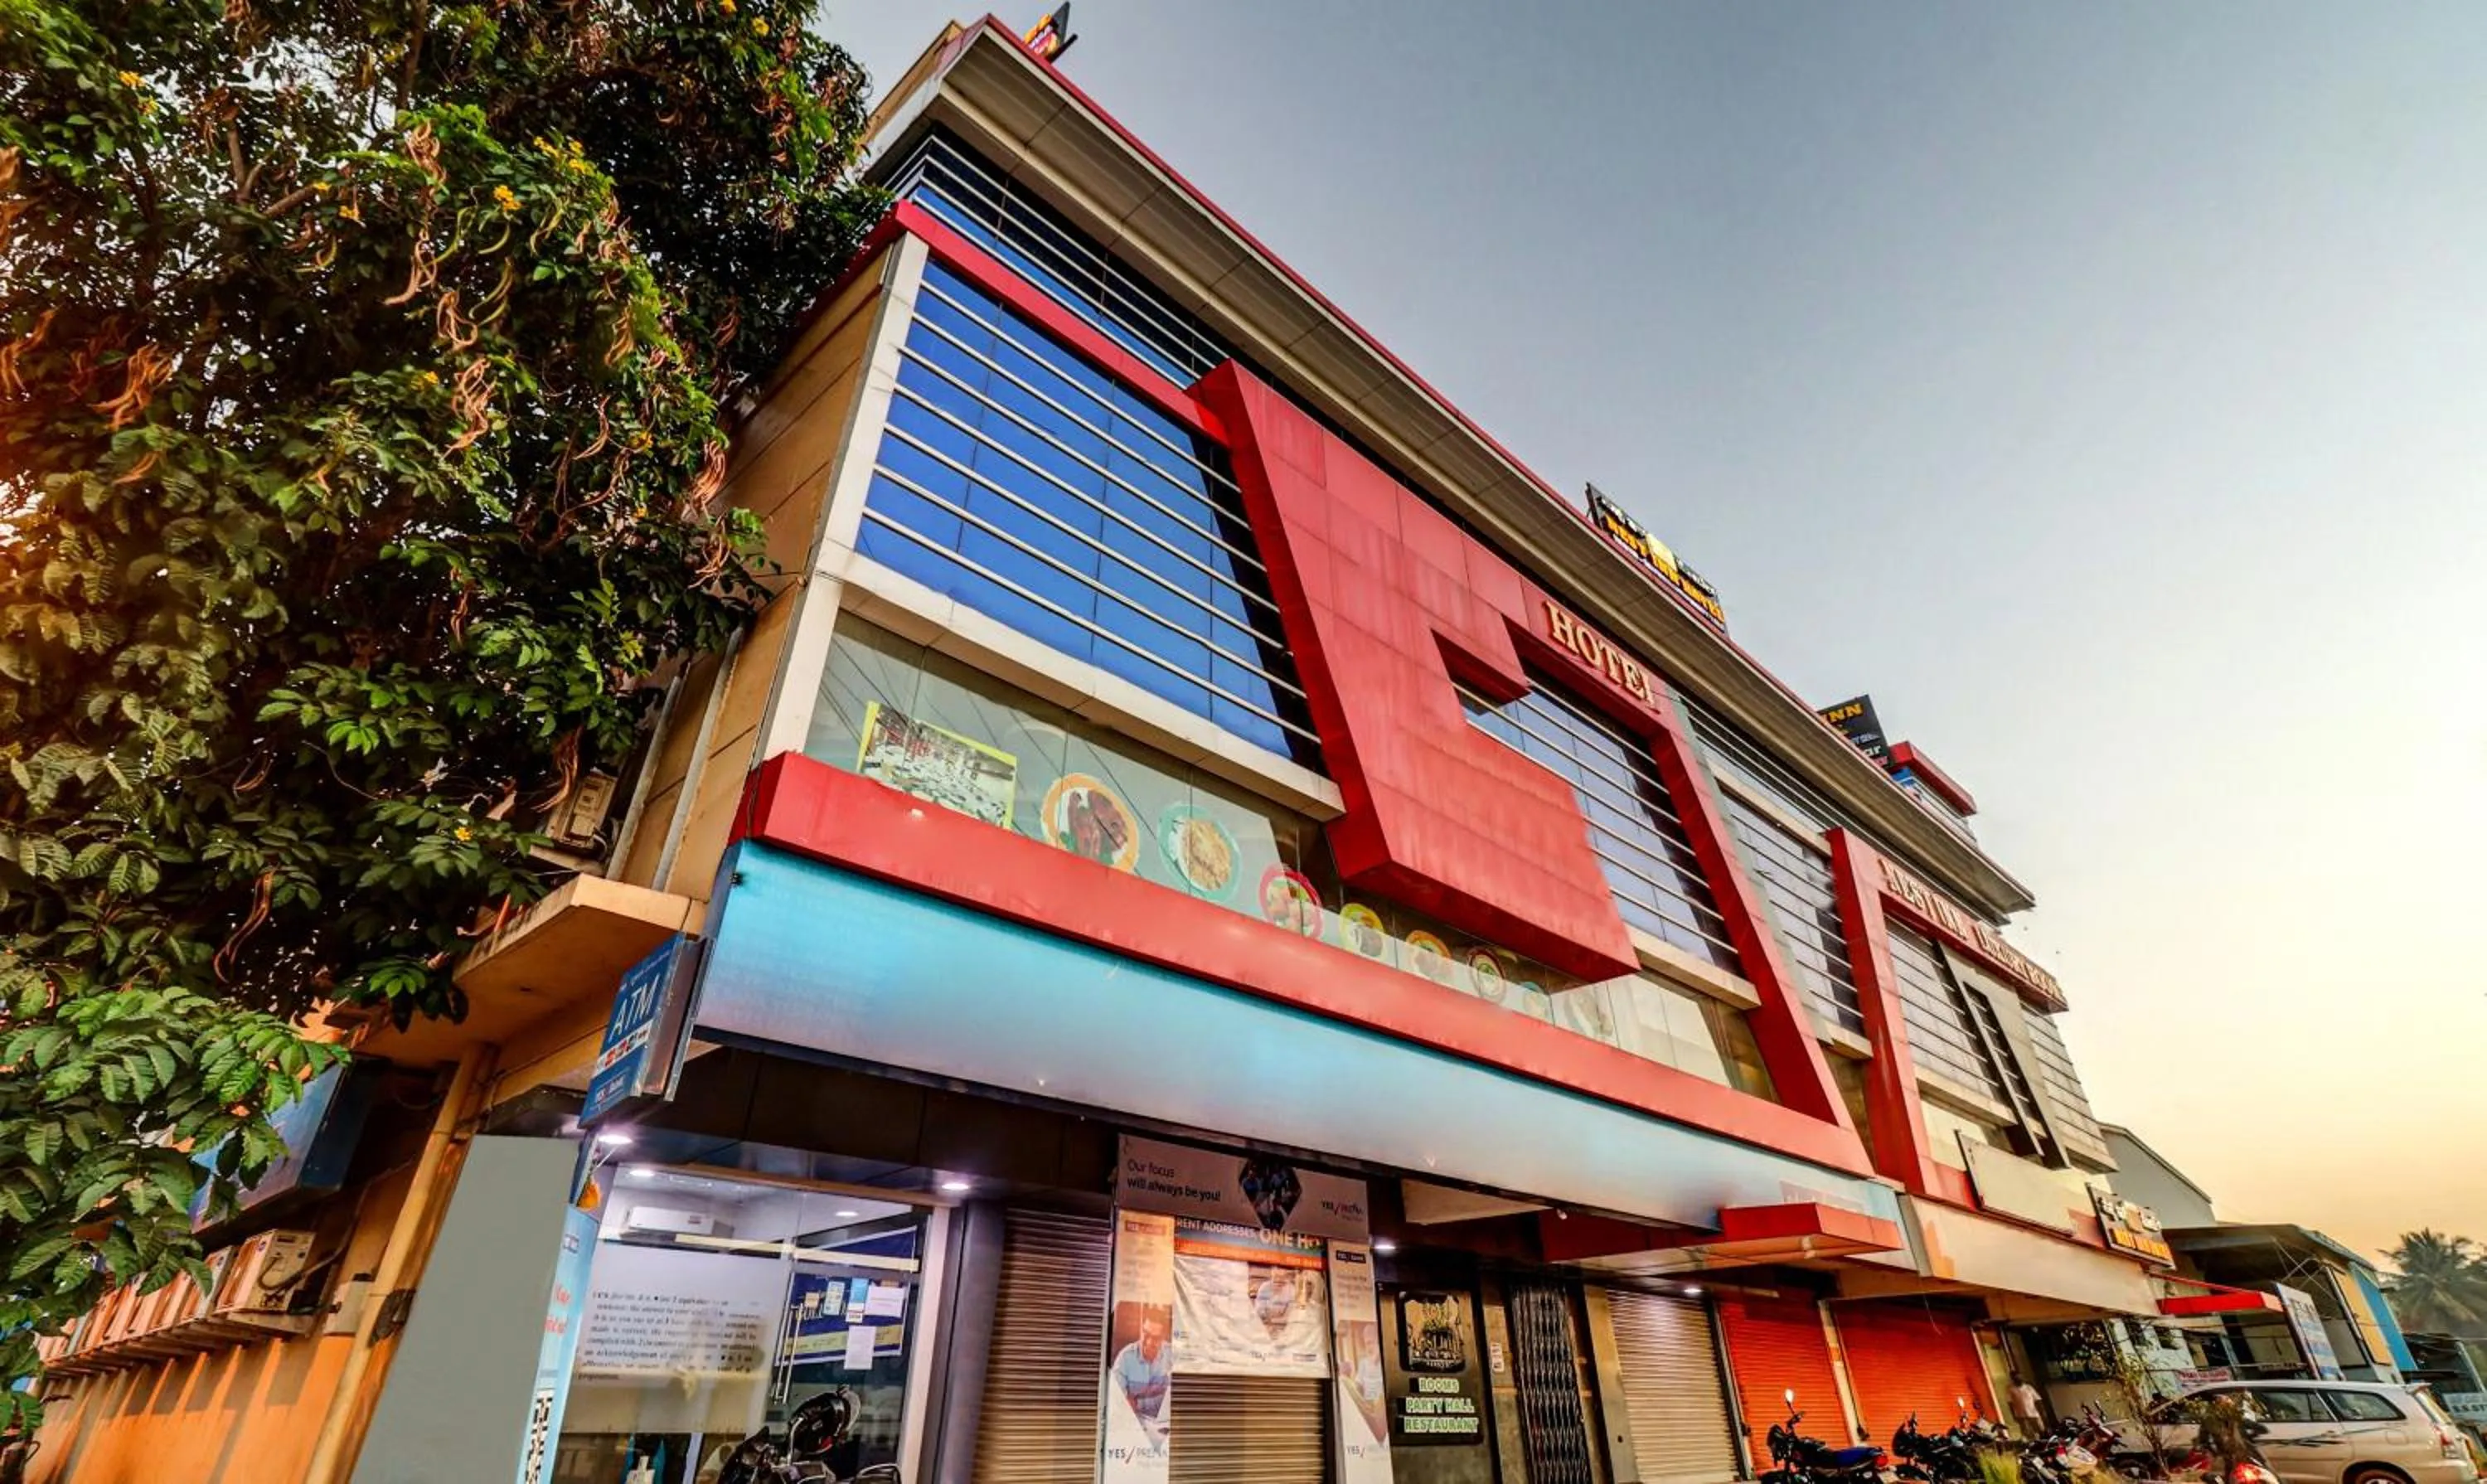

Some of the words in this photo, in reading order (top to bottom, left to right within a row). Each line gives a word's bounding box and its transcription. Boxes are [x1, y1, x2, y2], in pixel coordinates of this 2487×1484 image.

[1543, 599, 1660, 713] HOTEL
[607, 972, 661, 1044] ATM
[1127, 1159, 1146, 1172] Our
[1148, 1162, 1175, 1178] focus
[1127, 1177, 1146, 1190] will
[1147, 1180, 1183, 1198] always
[1185, 1185, 1198, 1197] be
[1259, 1228, 1294, 1248] ONE
[1419, 1377, 1459, 1393] ROOMS
[1406, 1397, 1443, 1414] PARTY
[1445, 1398, 1475, 1414] HALL
[1403, 1416, 1479, 1433] RESTAURANT
